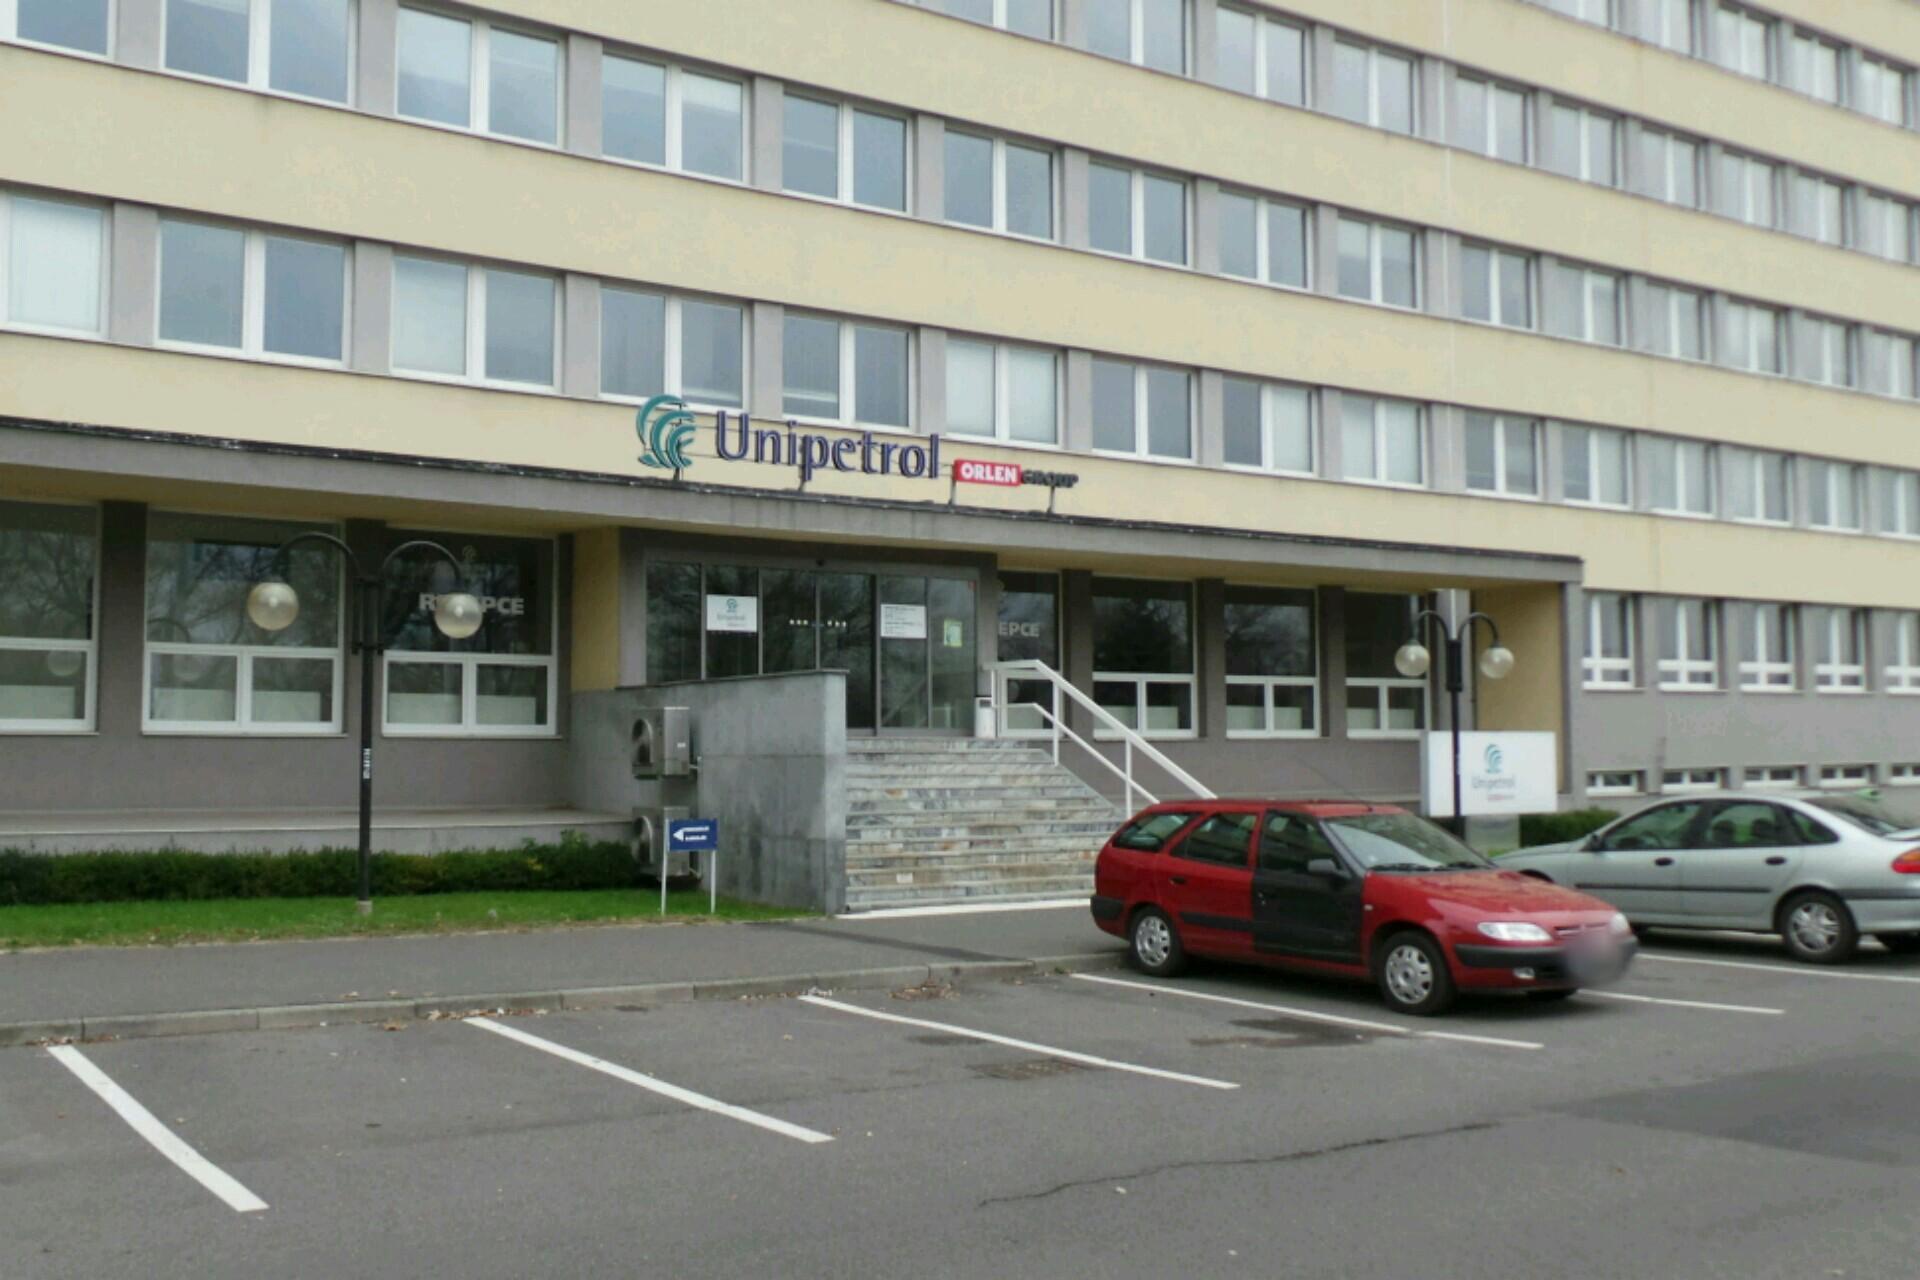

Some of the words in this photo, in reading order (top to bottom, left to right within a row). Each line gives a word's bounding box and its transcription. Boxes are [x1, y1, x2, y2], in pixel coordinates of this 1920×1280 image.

[716, 410, 939, 482] Unipetrol
[960, 461, 1018, 484] ORLEN
[419, 594, 525, 616] RPCE
